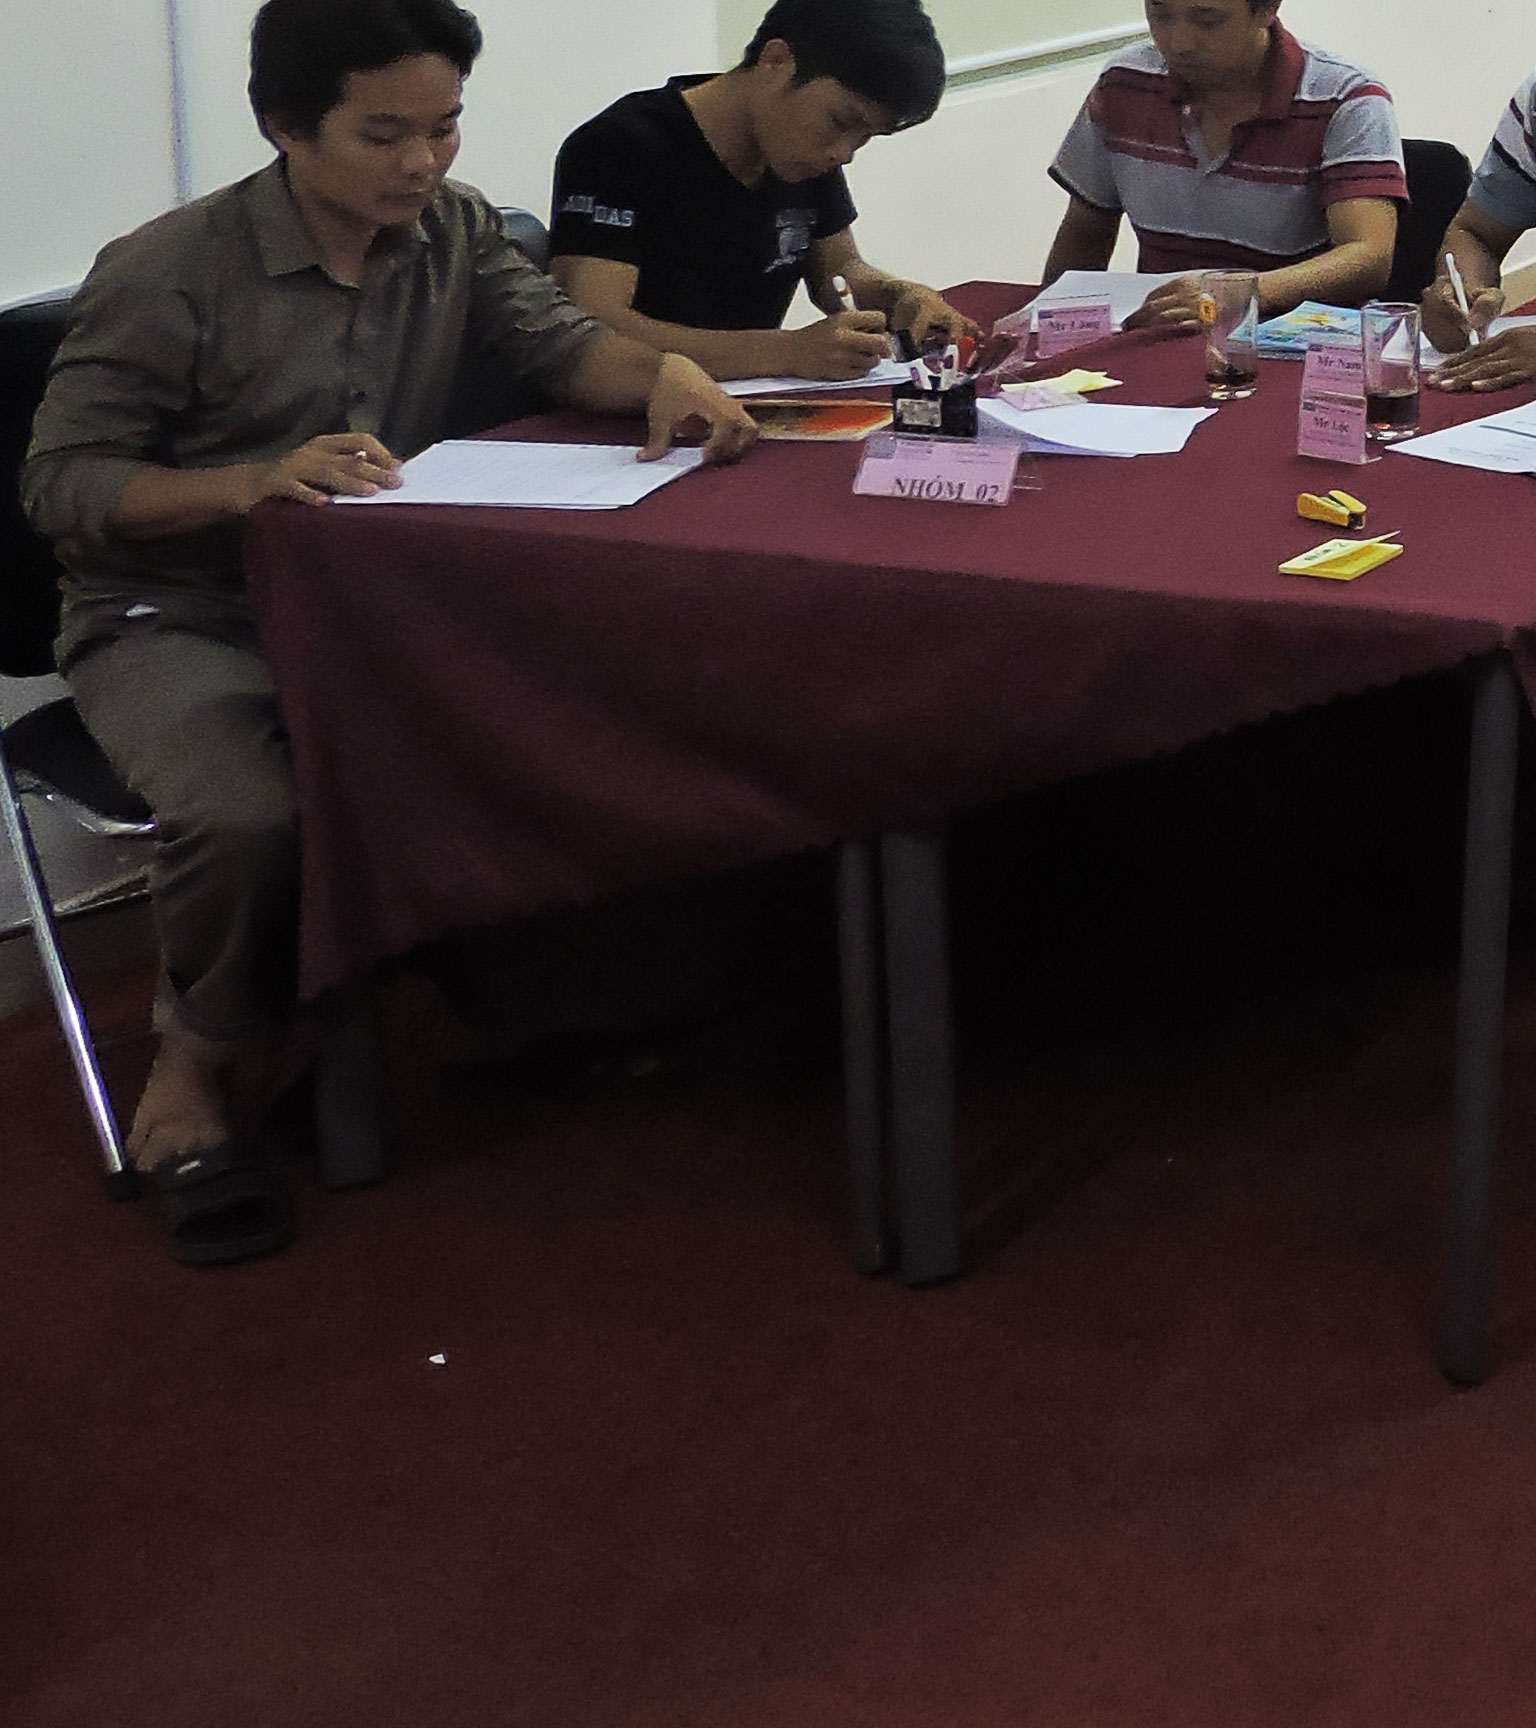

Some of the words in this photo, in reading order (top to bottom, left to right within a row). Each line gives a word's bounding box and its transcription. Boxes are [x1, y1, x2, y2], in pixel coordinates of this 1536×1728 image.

[1317, 355, 1335, 367] Mr
[1314, 416, 1329, 428] Mr
[895, 474, 967, 500] NHÓM
[976, 483, 999, 503] 02
